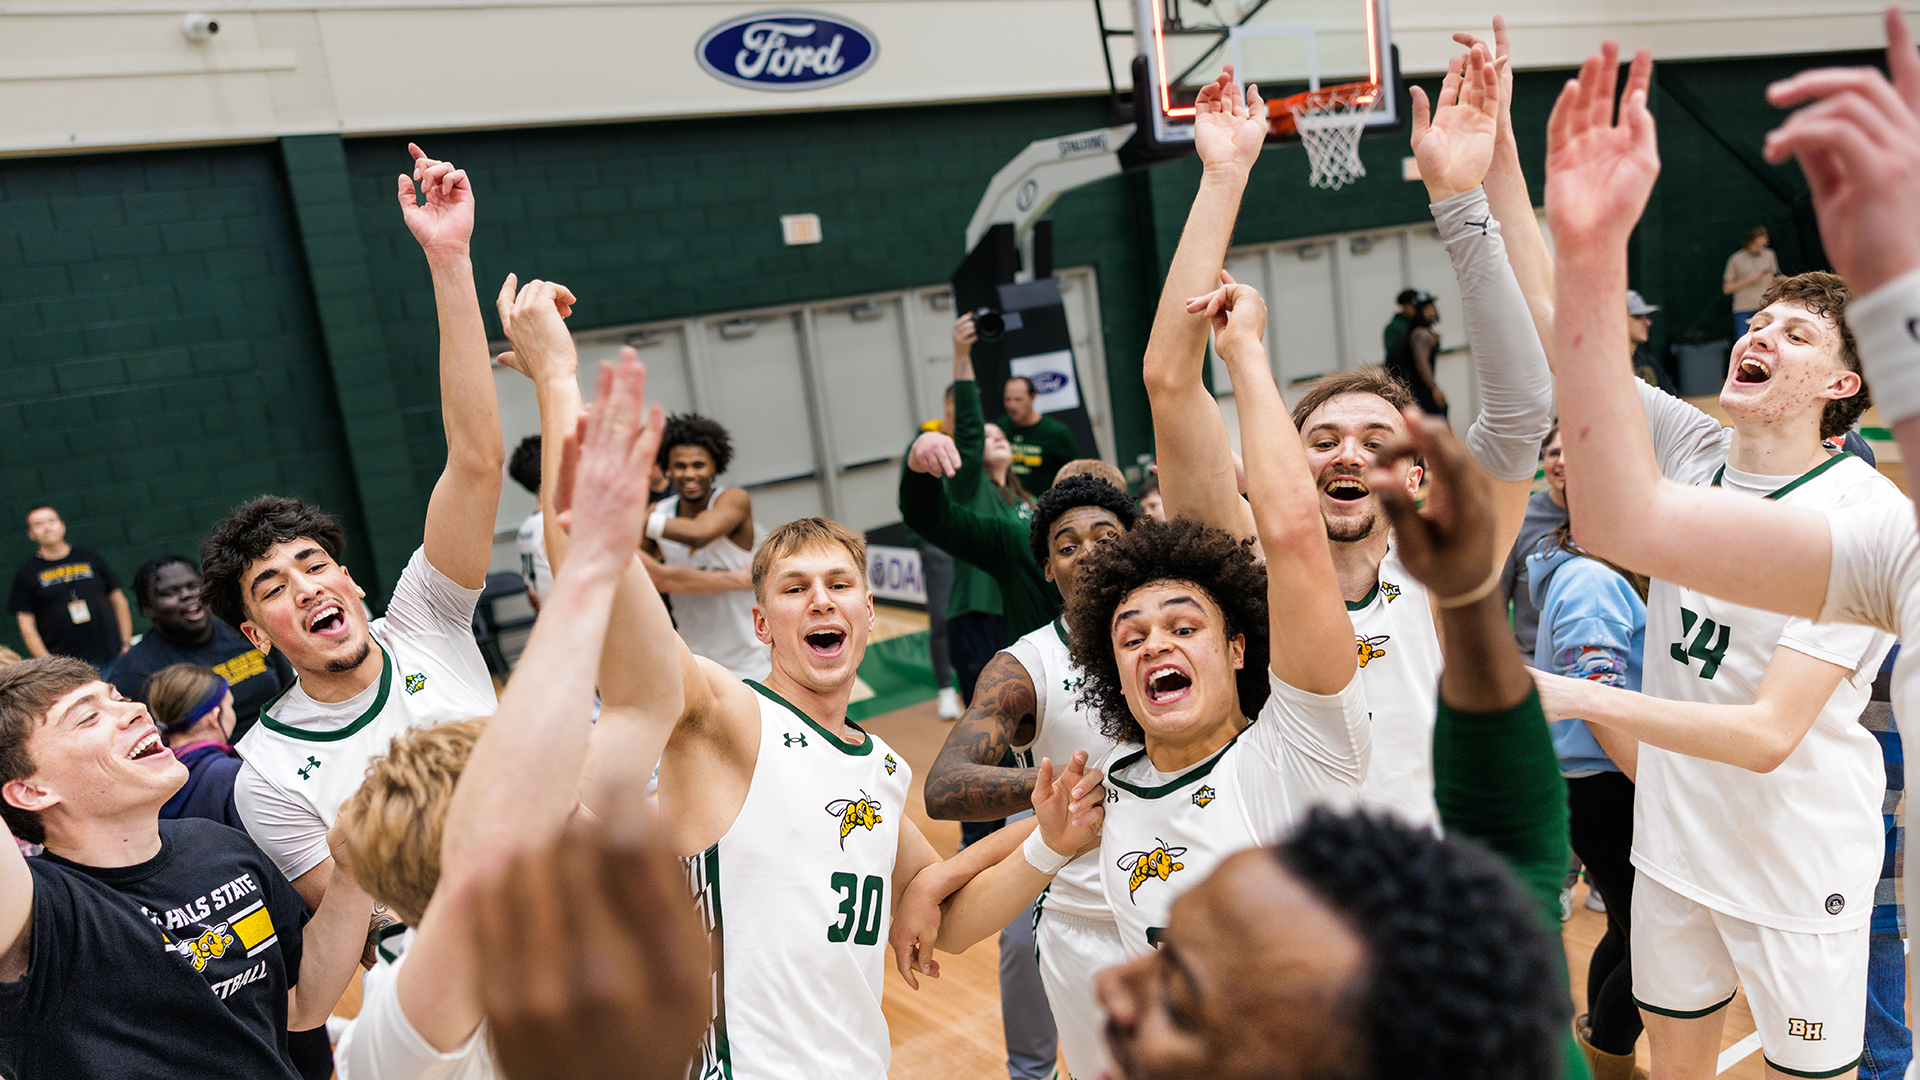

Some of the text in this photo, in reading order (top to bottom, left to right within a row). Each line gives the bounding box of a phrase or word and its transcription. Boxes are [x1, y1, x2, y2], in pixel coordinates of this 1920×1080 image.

[735, 22, 845, 78] Ford
[407, 674, 425, 693] RMAC
[210, 873, 258, 911] STATE
[827, 872, 884, 946] 30
[210, 960, 268, 1000] ETBALL
[1789, 1018, 1823, 1041] BH
